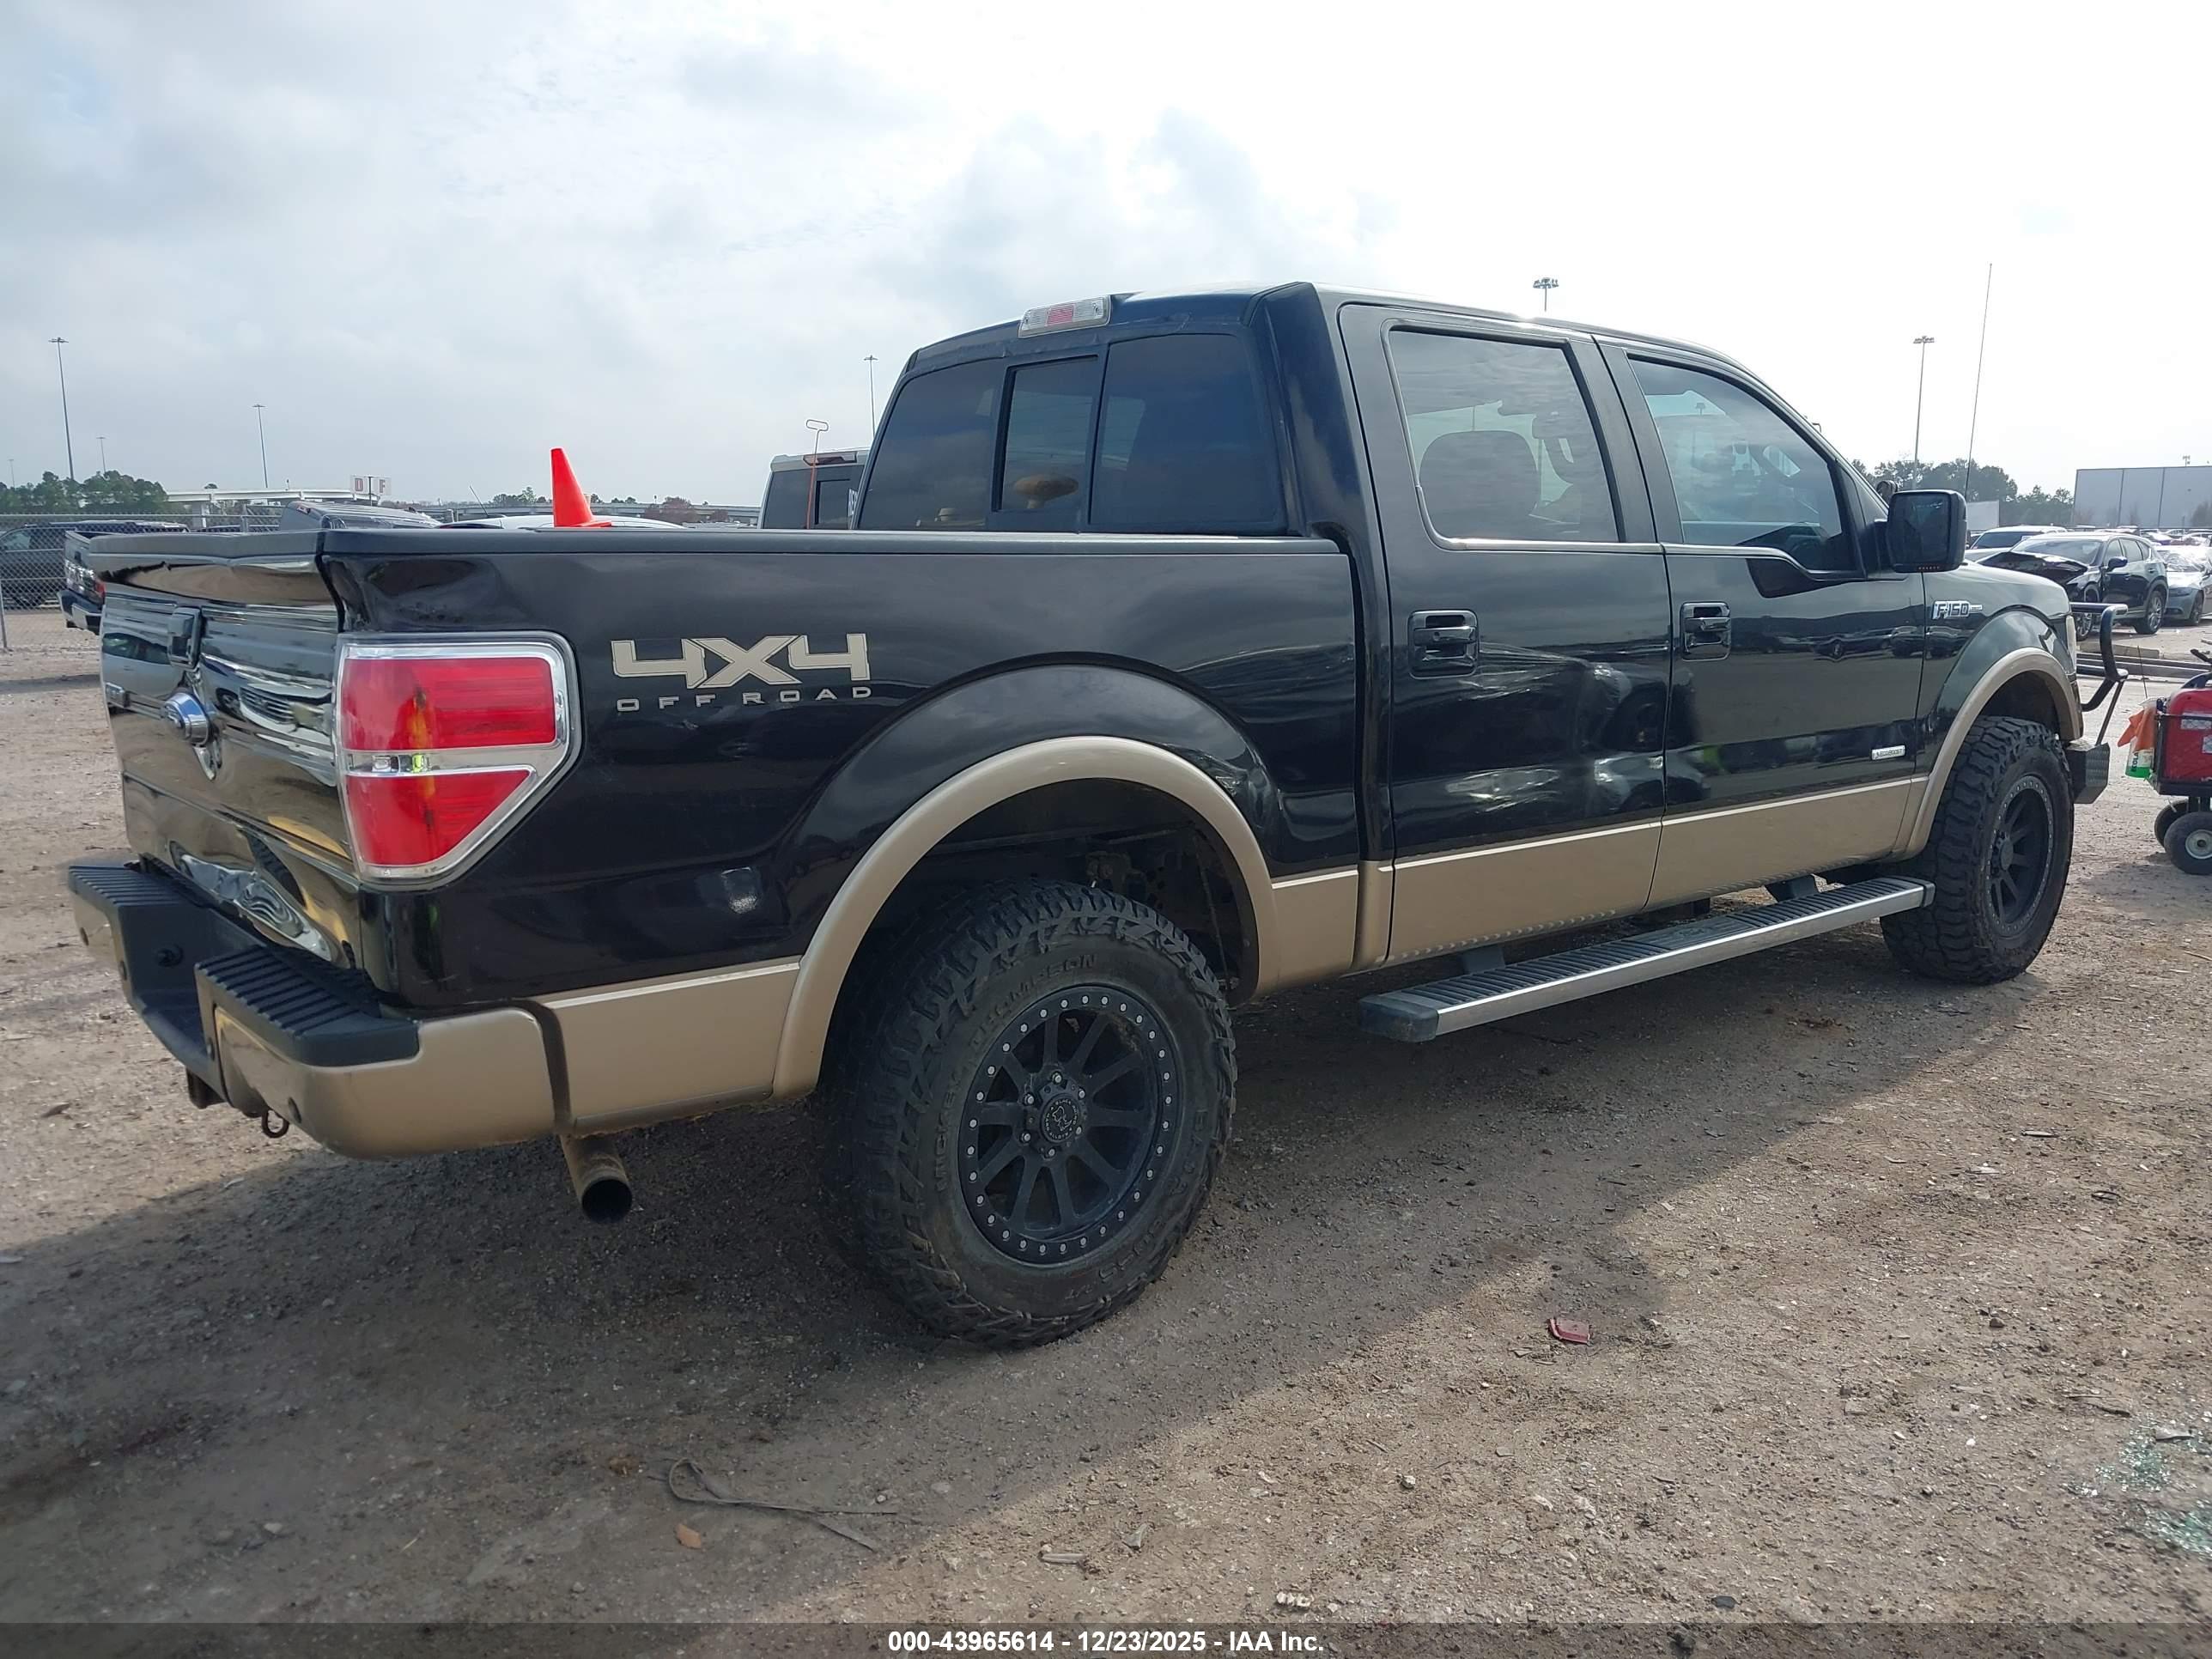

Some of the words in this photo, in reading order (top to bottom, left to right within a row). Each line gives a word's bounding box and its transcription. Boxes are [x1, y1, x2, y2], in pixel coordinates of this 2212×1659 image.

[611, 633, 871, 689] 4X4
[617, 694, 716, 712] OFF
[742, 687, 872, 705] ROAD
